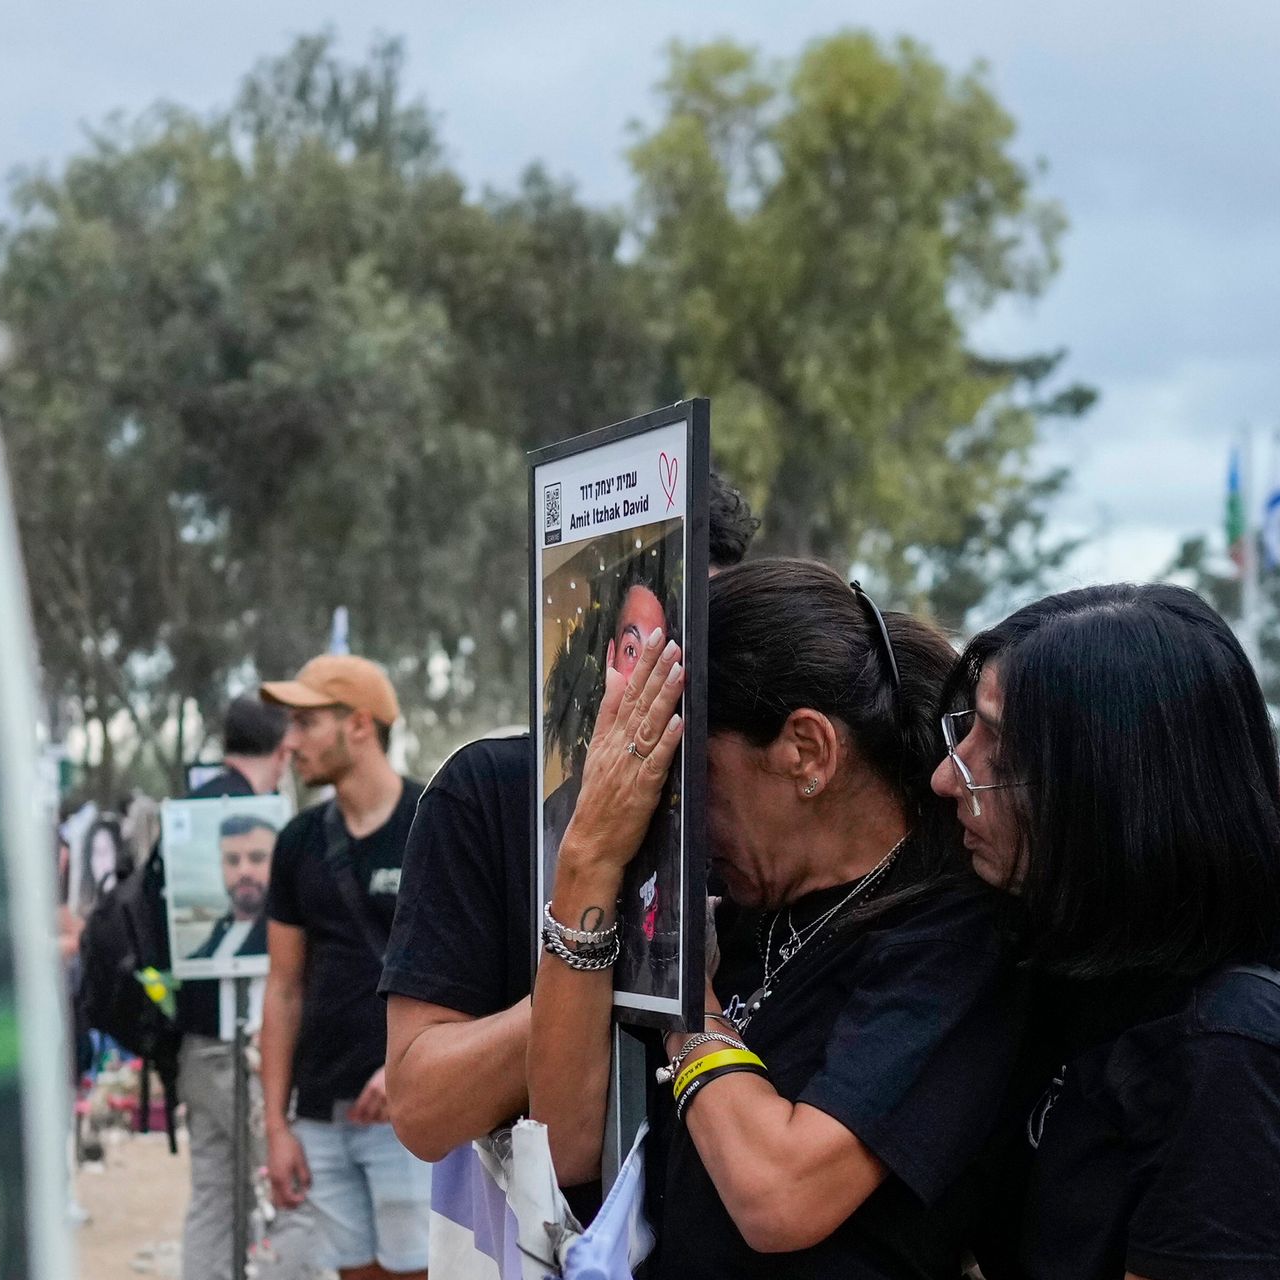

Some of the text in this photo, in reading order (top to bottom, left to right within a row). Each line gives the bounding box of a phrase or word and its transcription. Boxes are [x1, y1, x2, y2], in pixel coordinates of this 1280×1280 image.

[580, 471, 637, 501] עמית יצחק דוד
[569, 494, 649, 530] Amit Itzhak David
